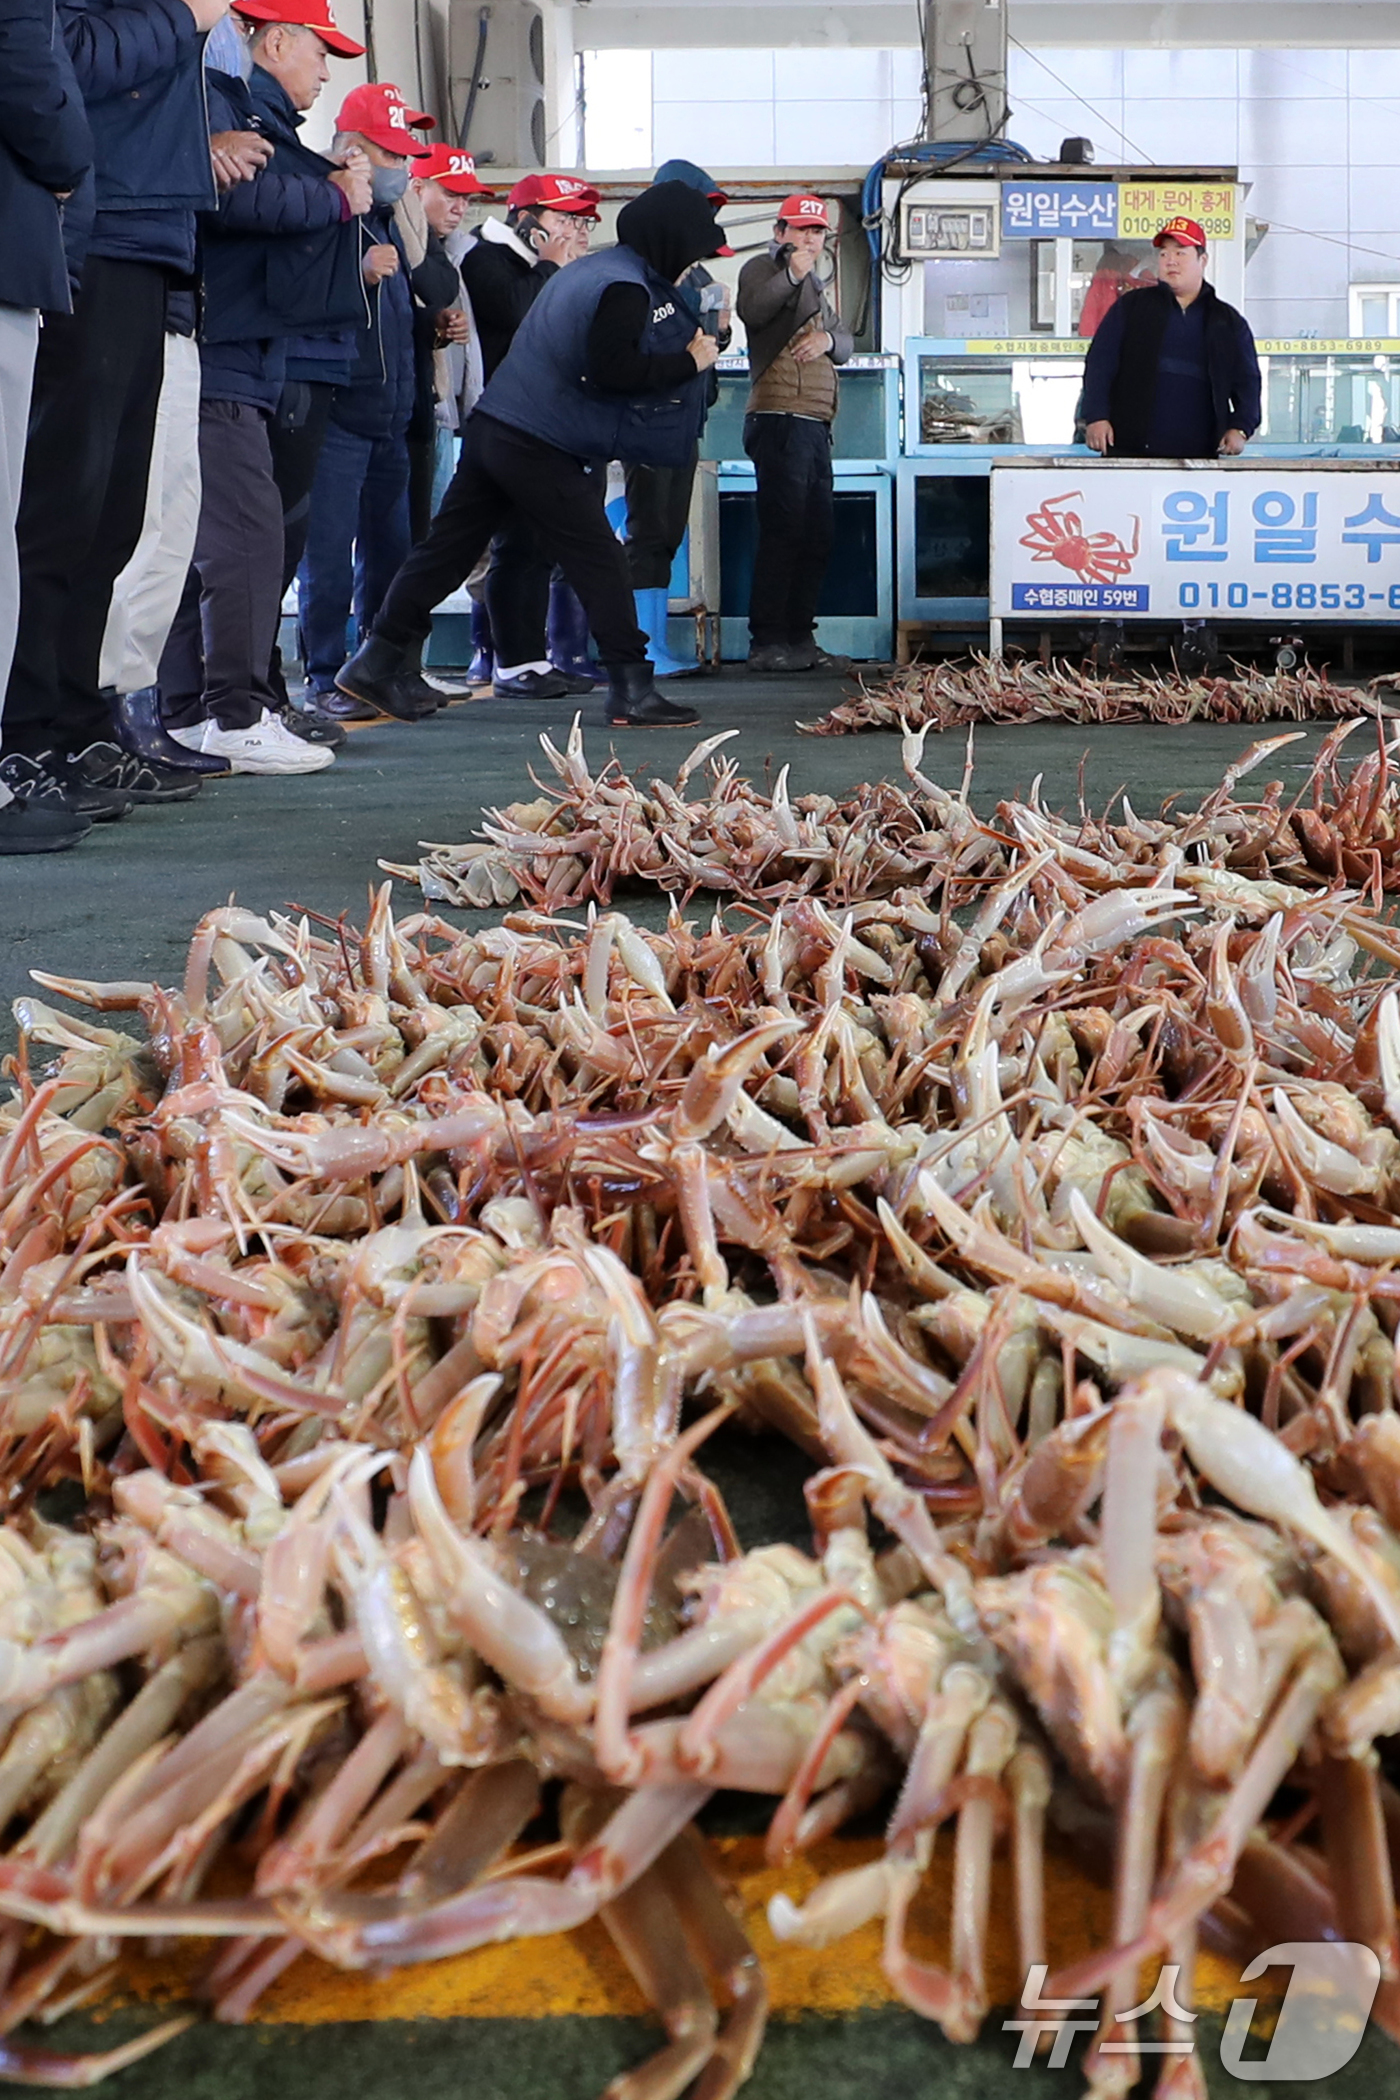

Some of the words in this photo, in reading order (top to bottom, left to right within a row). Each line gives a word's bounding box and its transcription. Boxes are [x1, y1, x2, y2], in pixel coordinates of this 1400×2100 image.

[800, 200, 823, 215] 217
[1006, 192, 1116, 228] 원일수산
[653, 302, 675, 323] 208
[1264, 341, 1382, 351] 010-8853-6989
[1024, 588, 1098, 606] 수협중매인
[1103, 589, 1137, 607] 59번
